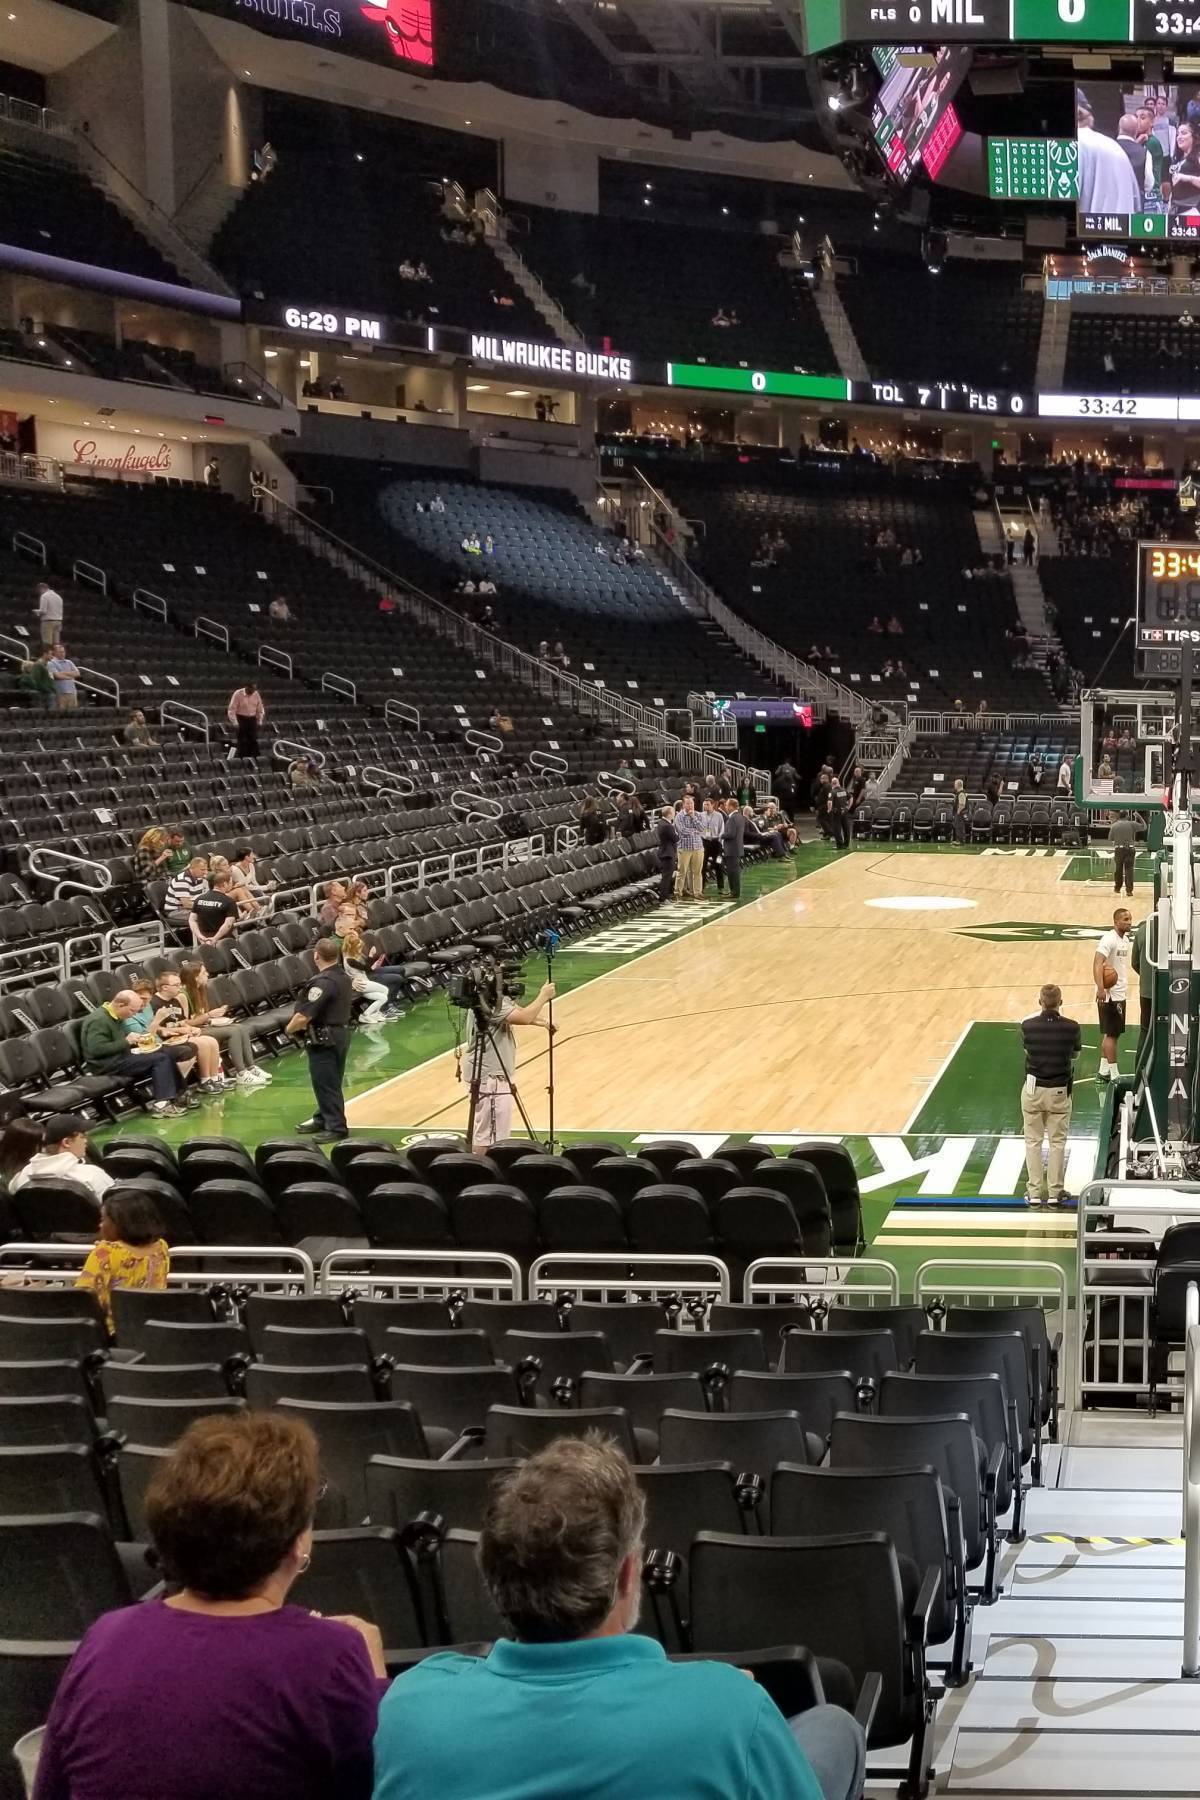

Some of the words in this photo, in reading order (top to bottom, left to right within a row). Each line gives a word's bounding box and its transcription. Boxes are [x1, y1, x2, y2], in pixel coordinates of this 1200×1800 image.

[870, 8, 896, 20] FLS
[909, 6, 921, 23] 0
[931, 0, 984, 23] MIL
[1105, 216, 1122, 231] MIL
[1144, 218, 1154, 232] 0
[1171, 227, 1197, 236] 33:43
[1086, 249, 1101, 261] JACK
[285, 308, 337, 333] 6:29
[345, 316, 380, 339] PM
[471, 334, 572, 372] MILWAUKEE
[575, 351, 632, 381] BUCKS
[752, 371, 766, 391] 0
[873, 384, 904, 402] TOL
[918, 388, 930, 405] 7
[969, 393, 998, 410] FLS
[1010, 396, 1023, 413] 0
[1078, 398, 1137, 416] 33:42
[1167, 1012, 1189, 1099] NBA
